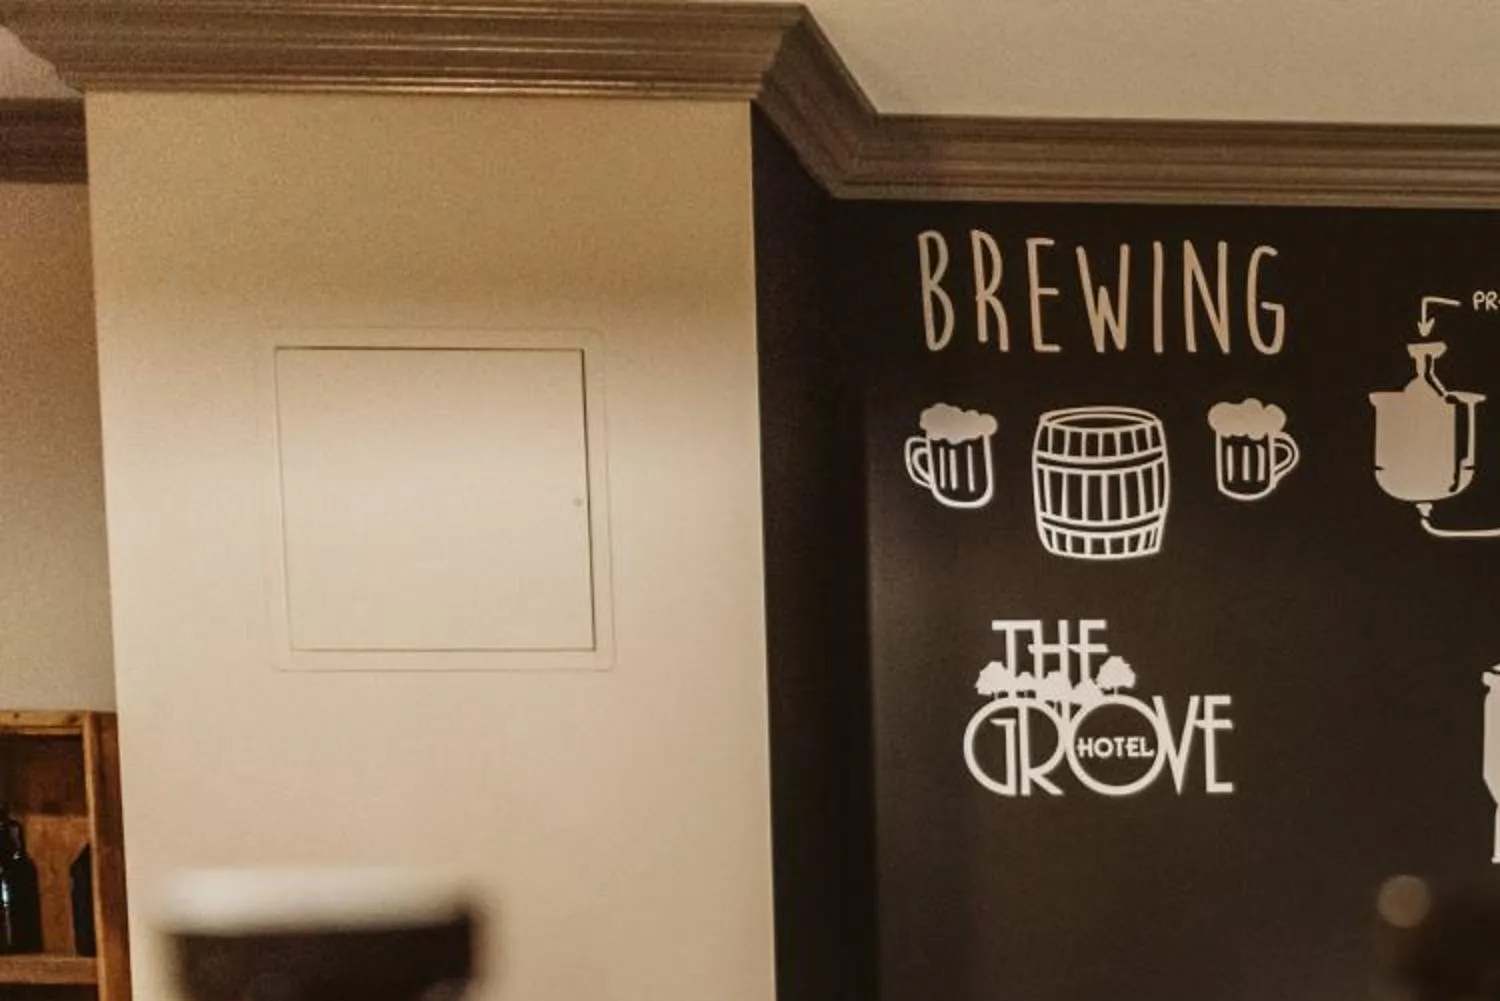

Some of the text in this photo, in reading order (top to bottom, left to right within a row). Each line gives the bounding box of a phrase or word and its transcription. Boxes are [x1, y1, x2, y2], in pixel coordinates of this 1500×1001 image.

[917, 229, 1287, 356] BREWING
[991, 619, 1109, 699] THE
[963, 694, 1234, 796] GROVE
[1077, 736, 1155, 758] HOTEL
